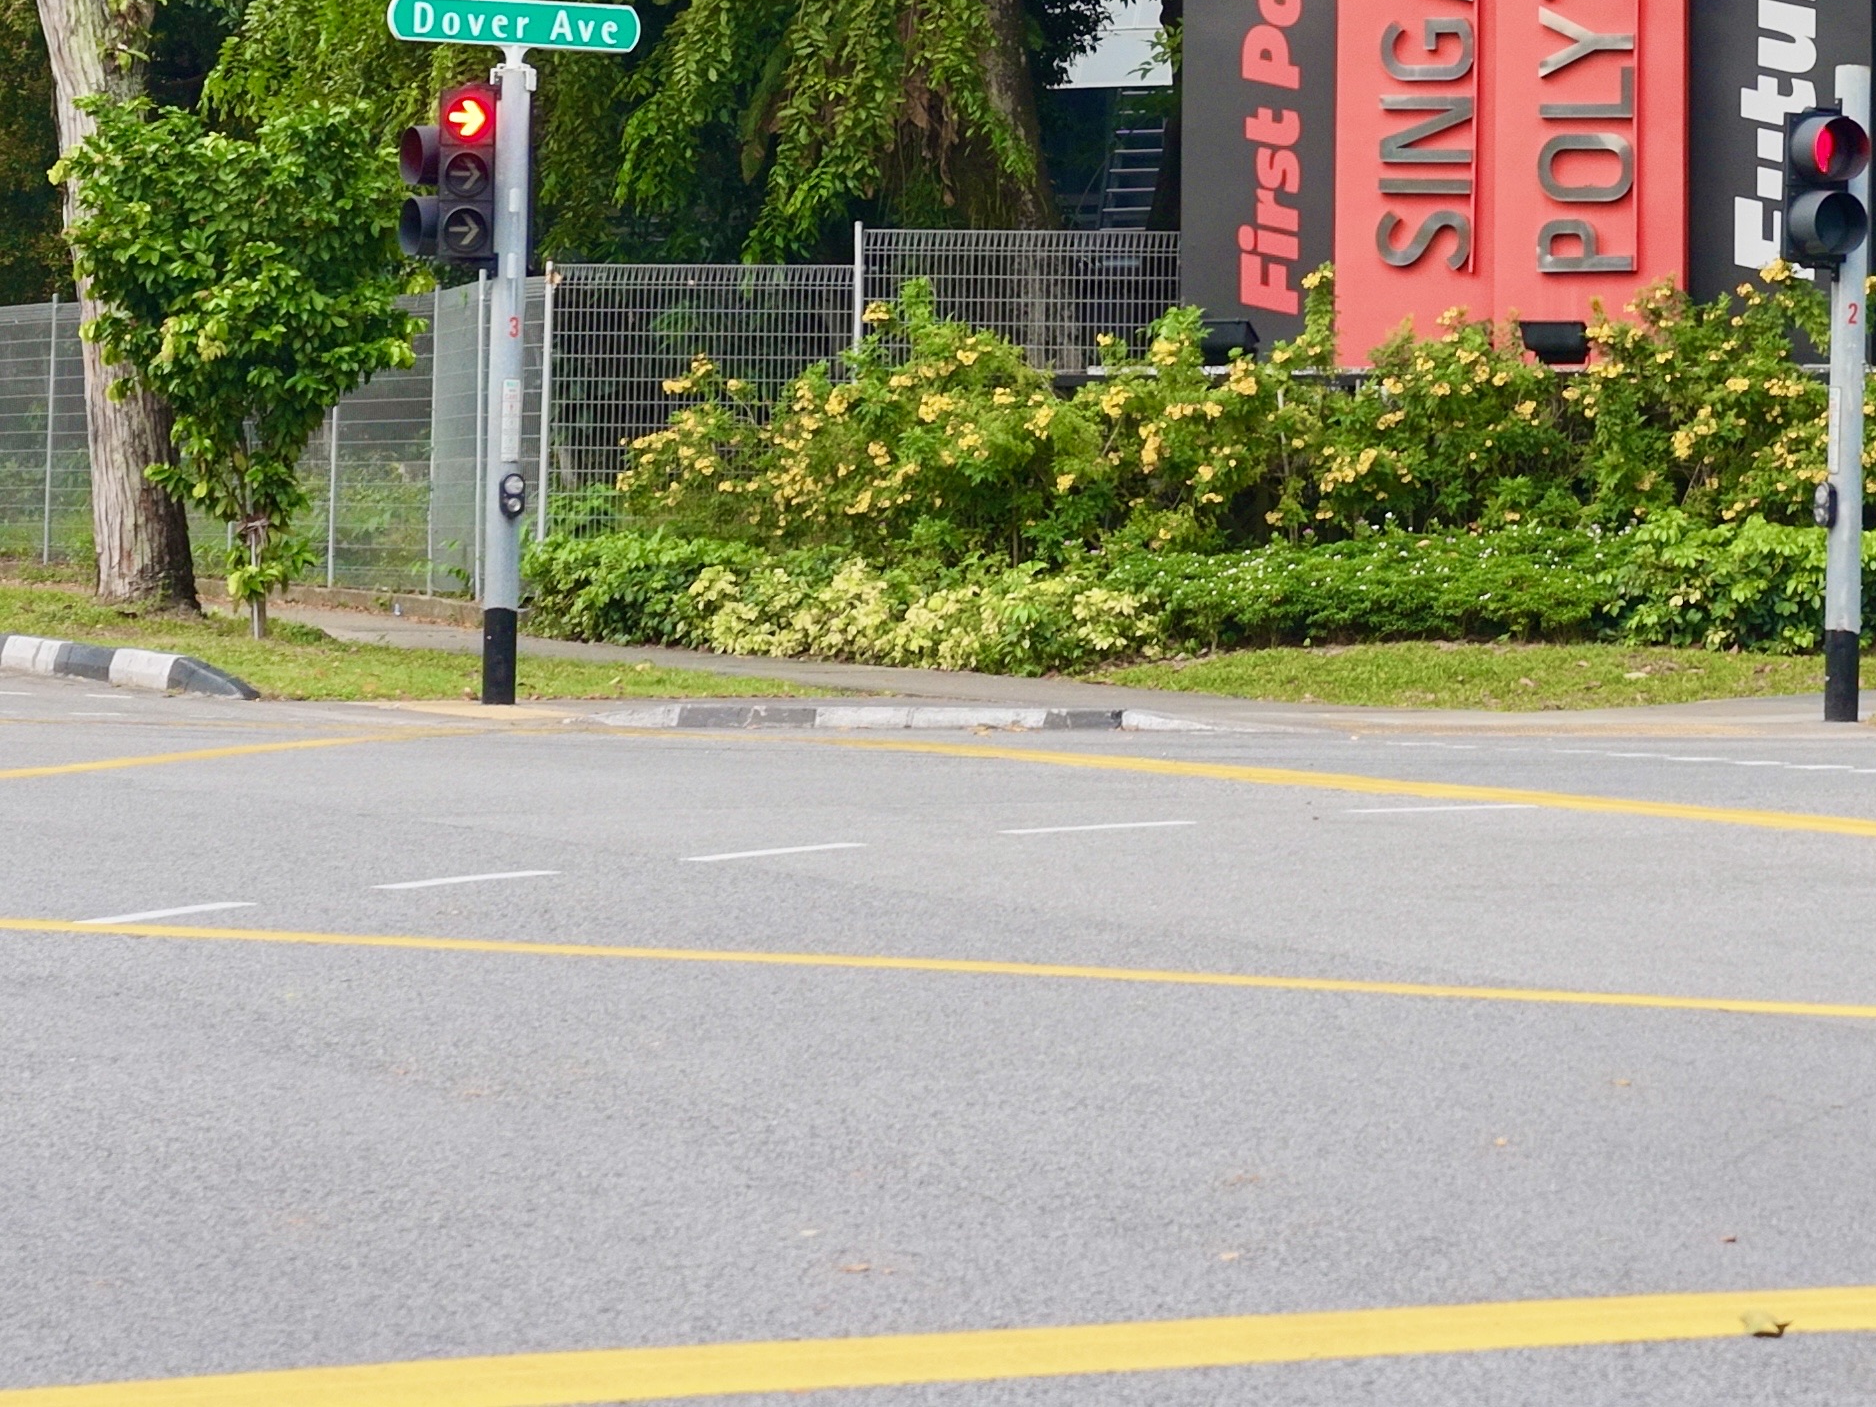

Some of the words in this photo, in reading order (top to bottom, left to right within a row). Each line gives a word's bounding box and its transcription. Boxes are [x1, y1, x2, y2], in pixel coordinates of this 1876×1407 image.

[412, 0, 530, 39] Dover
[550, 9, 619, 45] Ave
[1237, 106, 1303, 316] First
[510, 316, 519, 338] 3
[1847, 302, 1858, 325] 2
